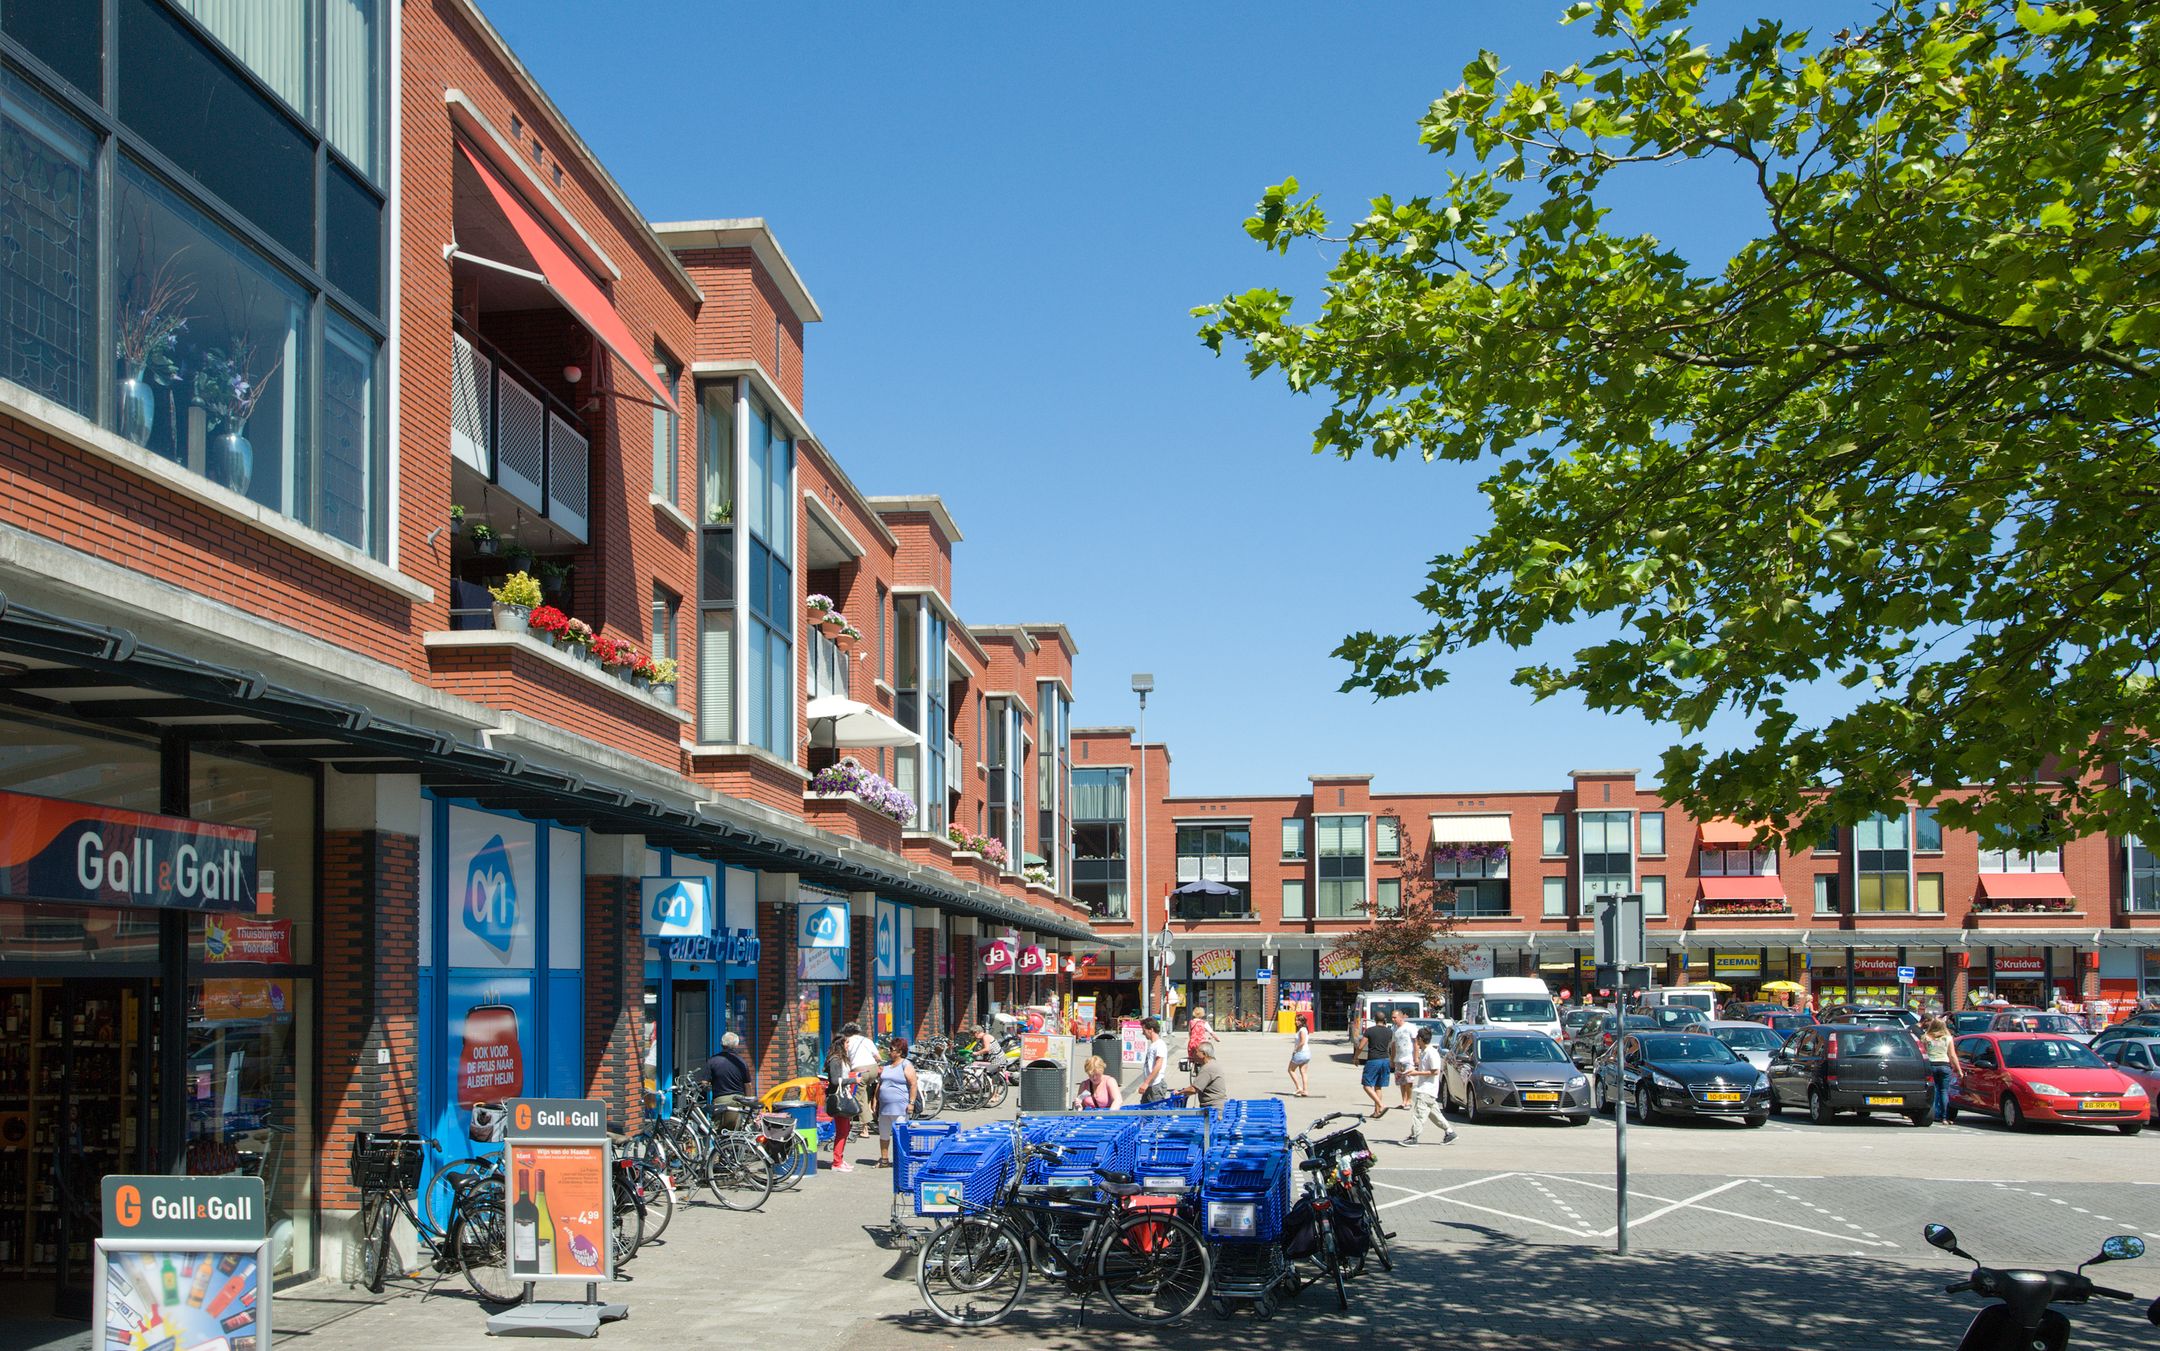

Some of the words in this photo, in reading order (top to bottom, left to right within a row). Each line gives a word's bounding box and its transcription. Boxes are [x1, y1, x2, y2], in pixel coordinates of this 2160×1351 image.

[983, 947, 1005, 966] da
[1018, 952, 1037, 968] da
[1192, 949, 1235, 973] SCHOENEN
[1716, 958, 1758, 966] ZEEMAN
[1861, 959, 1897, 969] Kruidvat
[2003, 959, 2041, 969] Kruidvat
[1206, 958, 1231, 975] REUS
[1289, 982, 1312, 992] SALE
[1289, 1000, 1313, 1011] SALE
[473, 1046, 488, 1060] OOK
[490, 1045, 509, 1058] VOOR
[467, 1062, 477, 1074] DE
[477, 1060, 496, 1073] PRIJS
[496, 1058, 514, 1071] NAAR
[467, 1073, 494, 1089] ALBERT
[494, 1072, 514, 1086] HEIJN
[515, 1104, 532, 1131] G
[115, 1184, 142, 1228] G
